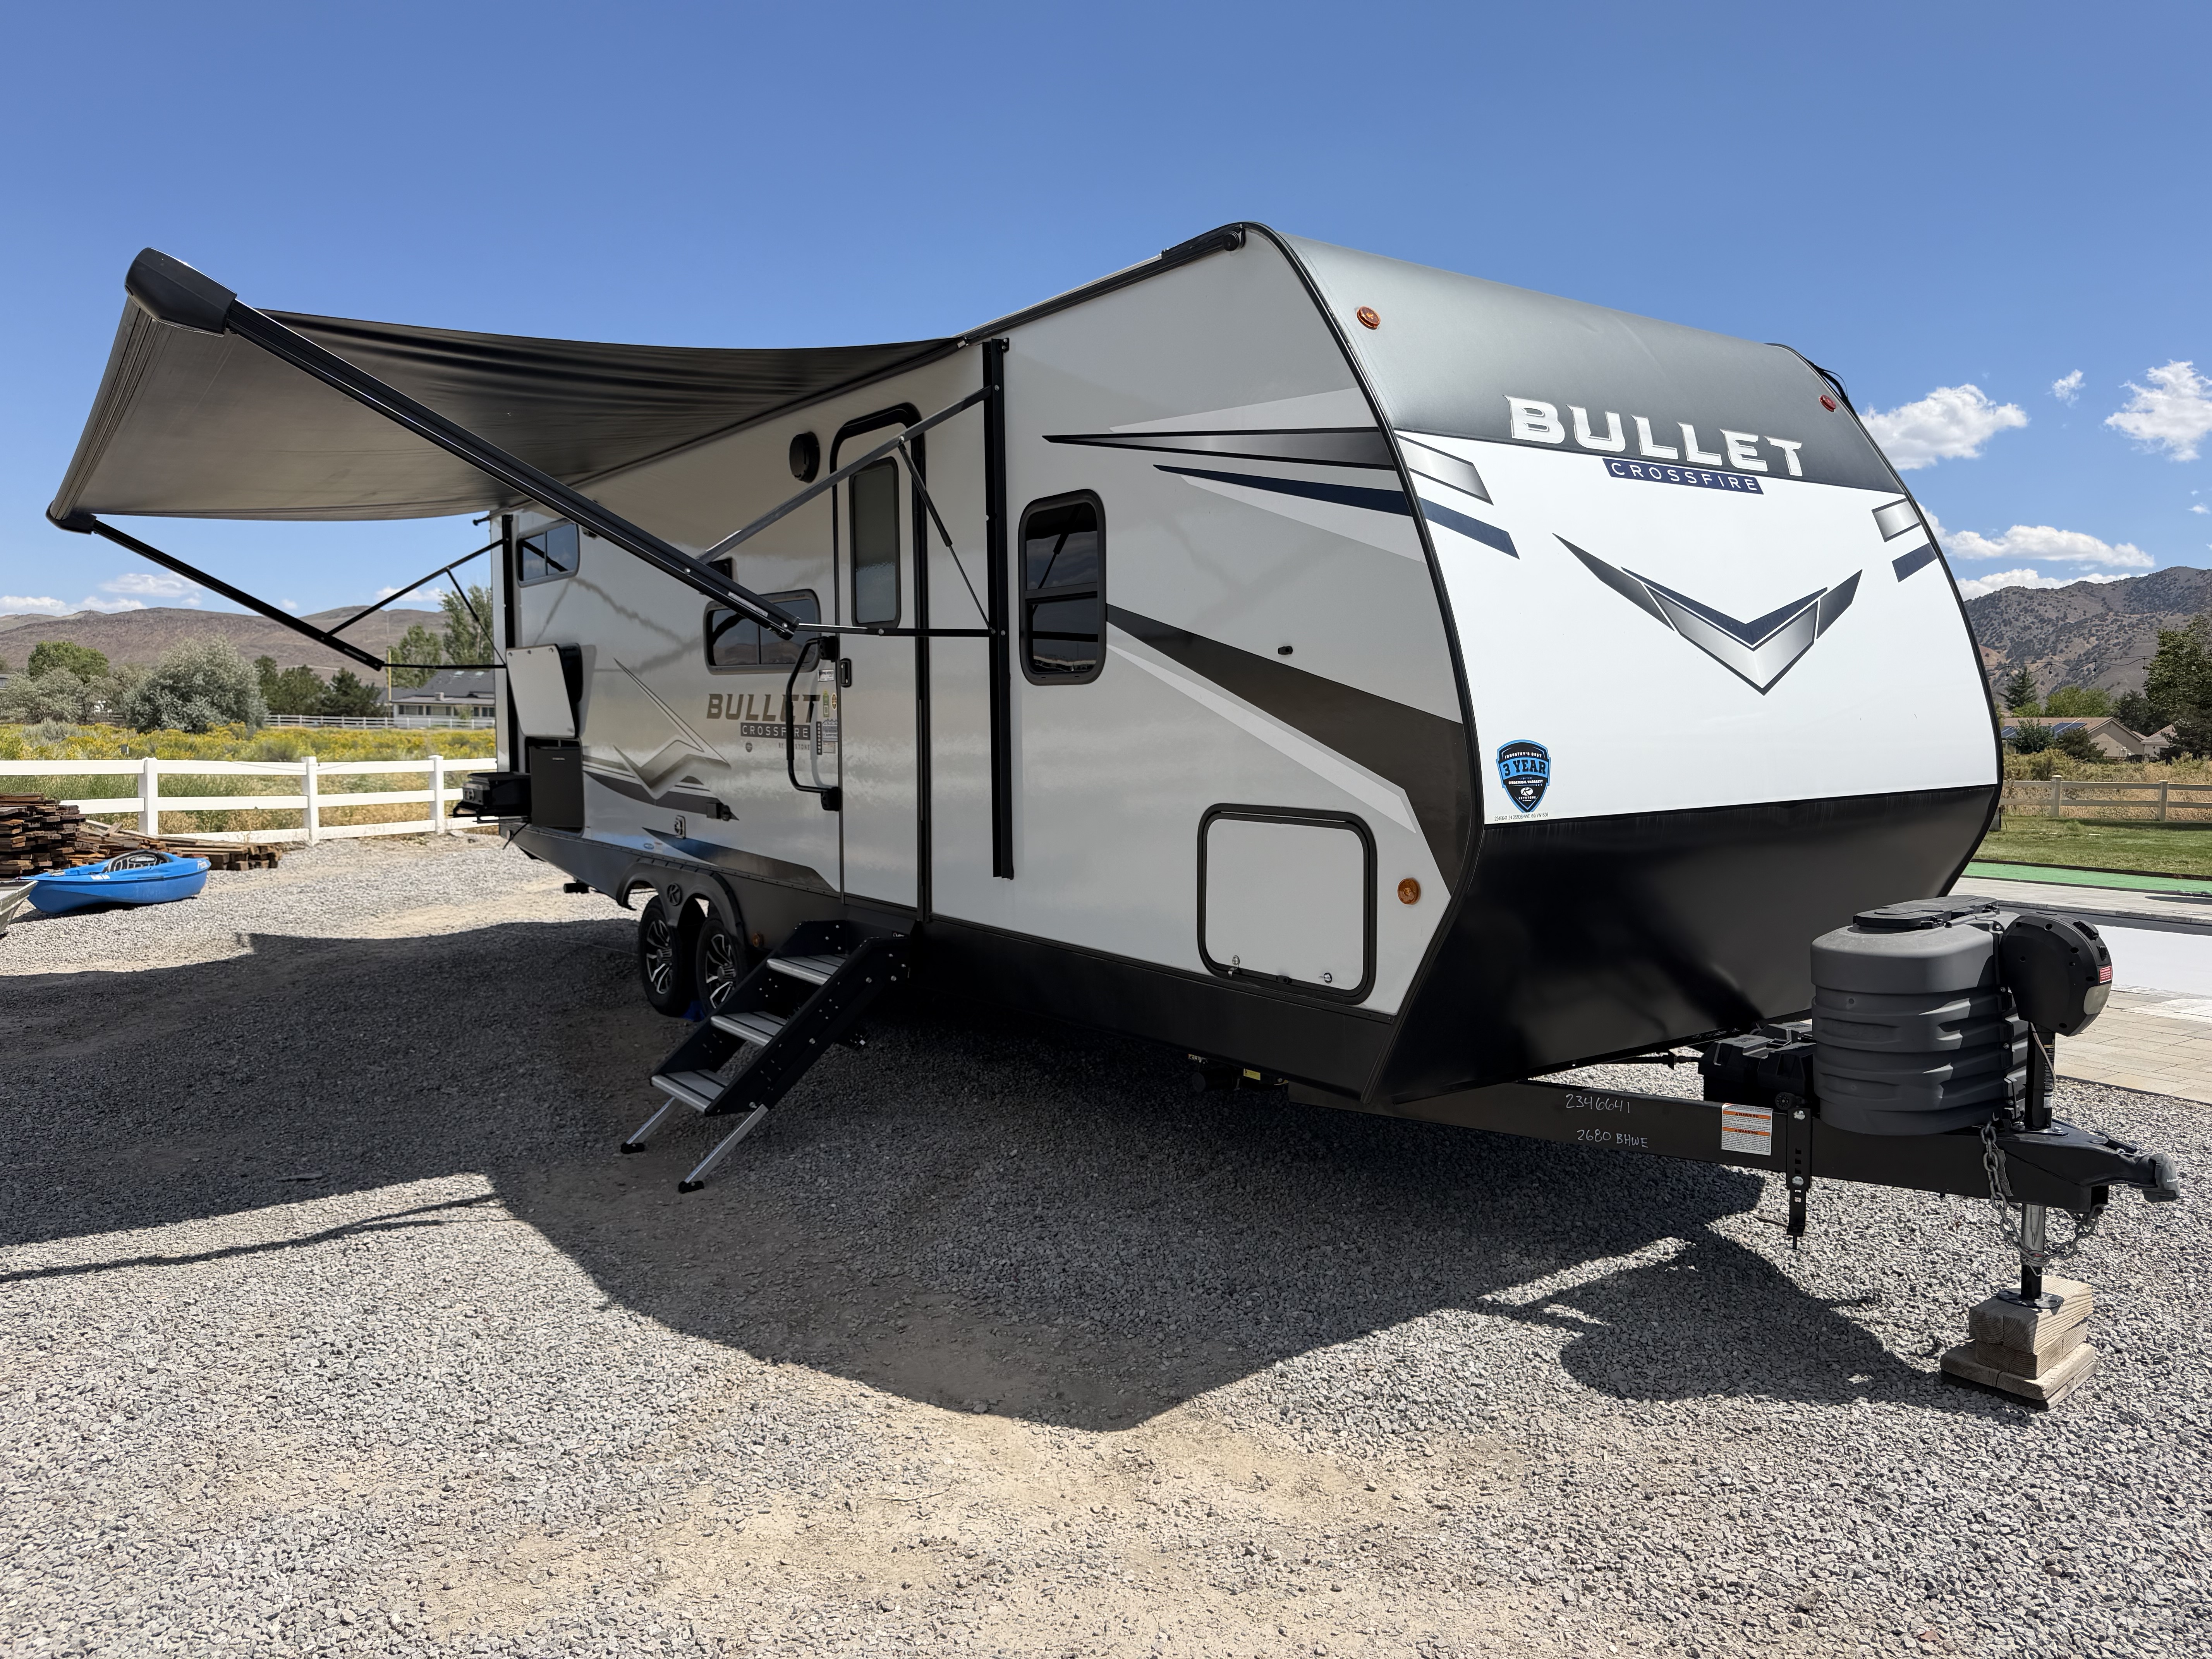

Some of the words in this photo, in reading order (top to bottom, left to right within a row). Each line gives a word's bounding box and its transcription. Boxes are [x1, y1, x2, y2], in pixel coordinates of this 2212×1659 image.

[1503, 395, 1803, 477] BULLET
[1611, 462, 1758, 491] CROSSFIRE
[707, 694, 821, 723] BULLET
[742, 725, 808, 738] CROSSFRE
[1503, 763, 1511, 776] 3
[1513, 759, 1546, 775] YEAR
[1565, 1094, 1630, 1113] 2346641
[1577, 1129, 1611, 1142] 2680
[1616, 1133, 1649, 1148] BHWE
